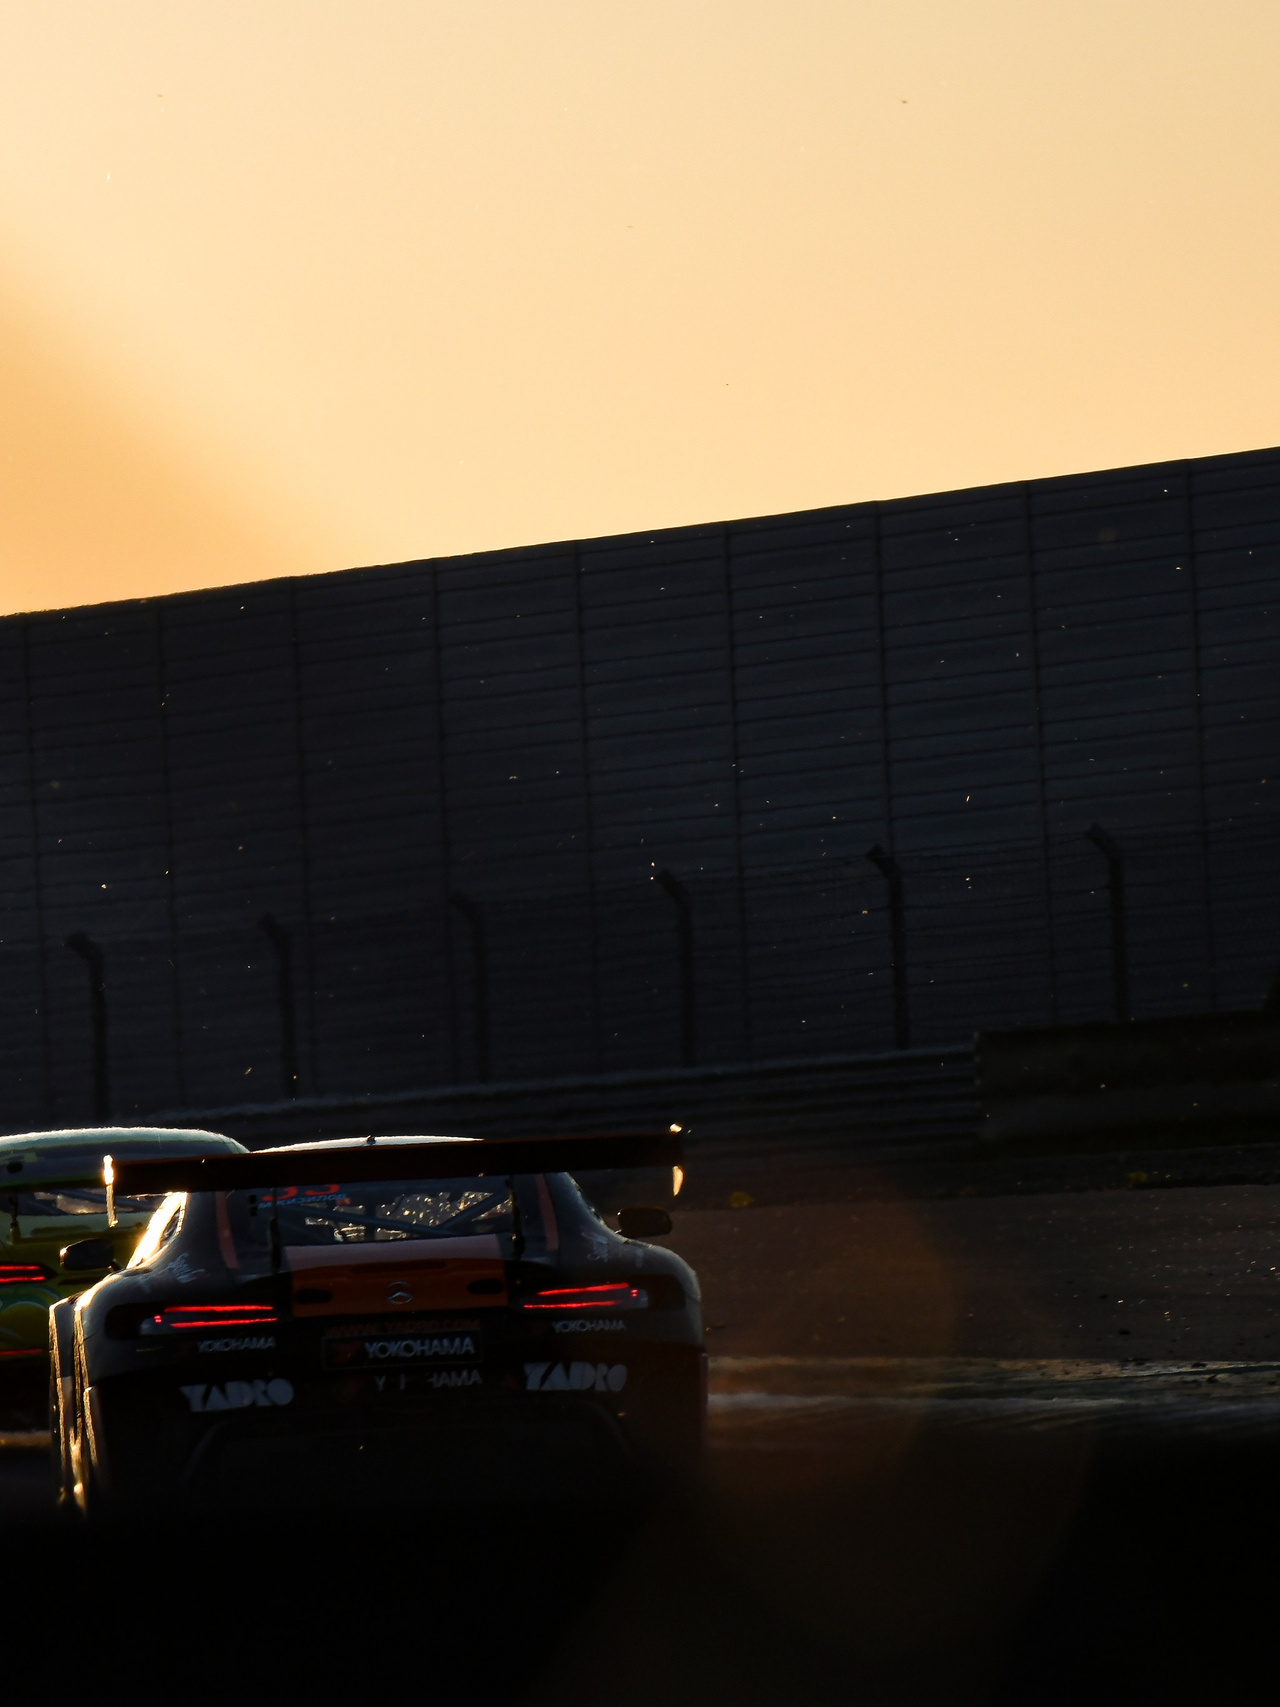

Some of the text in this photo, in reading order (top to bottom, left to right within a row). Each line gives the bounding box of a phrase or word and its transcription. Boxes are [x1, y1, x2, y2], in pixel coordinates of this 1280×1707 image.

[551, 1319, 628, 1334] YOKOHAMA
[196, 1335, 278, 1353] YOKOHAMA
[363, 1335, 477, 1359] YOKOHAMA
[522, 1360, 629, 1393] YADRO
[178, 1377, 296, 1413] YADRO
